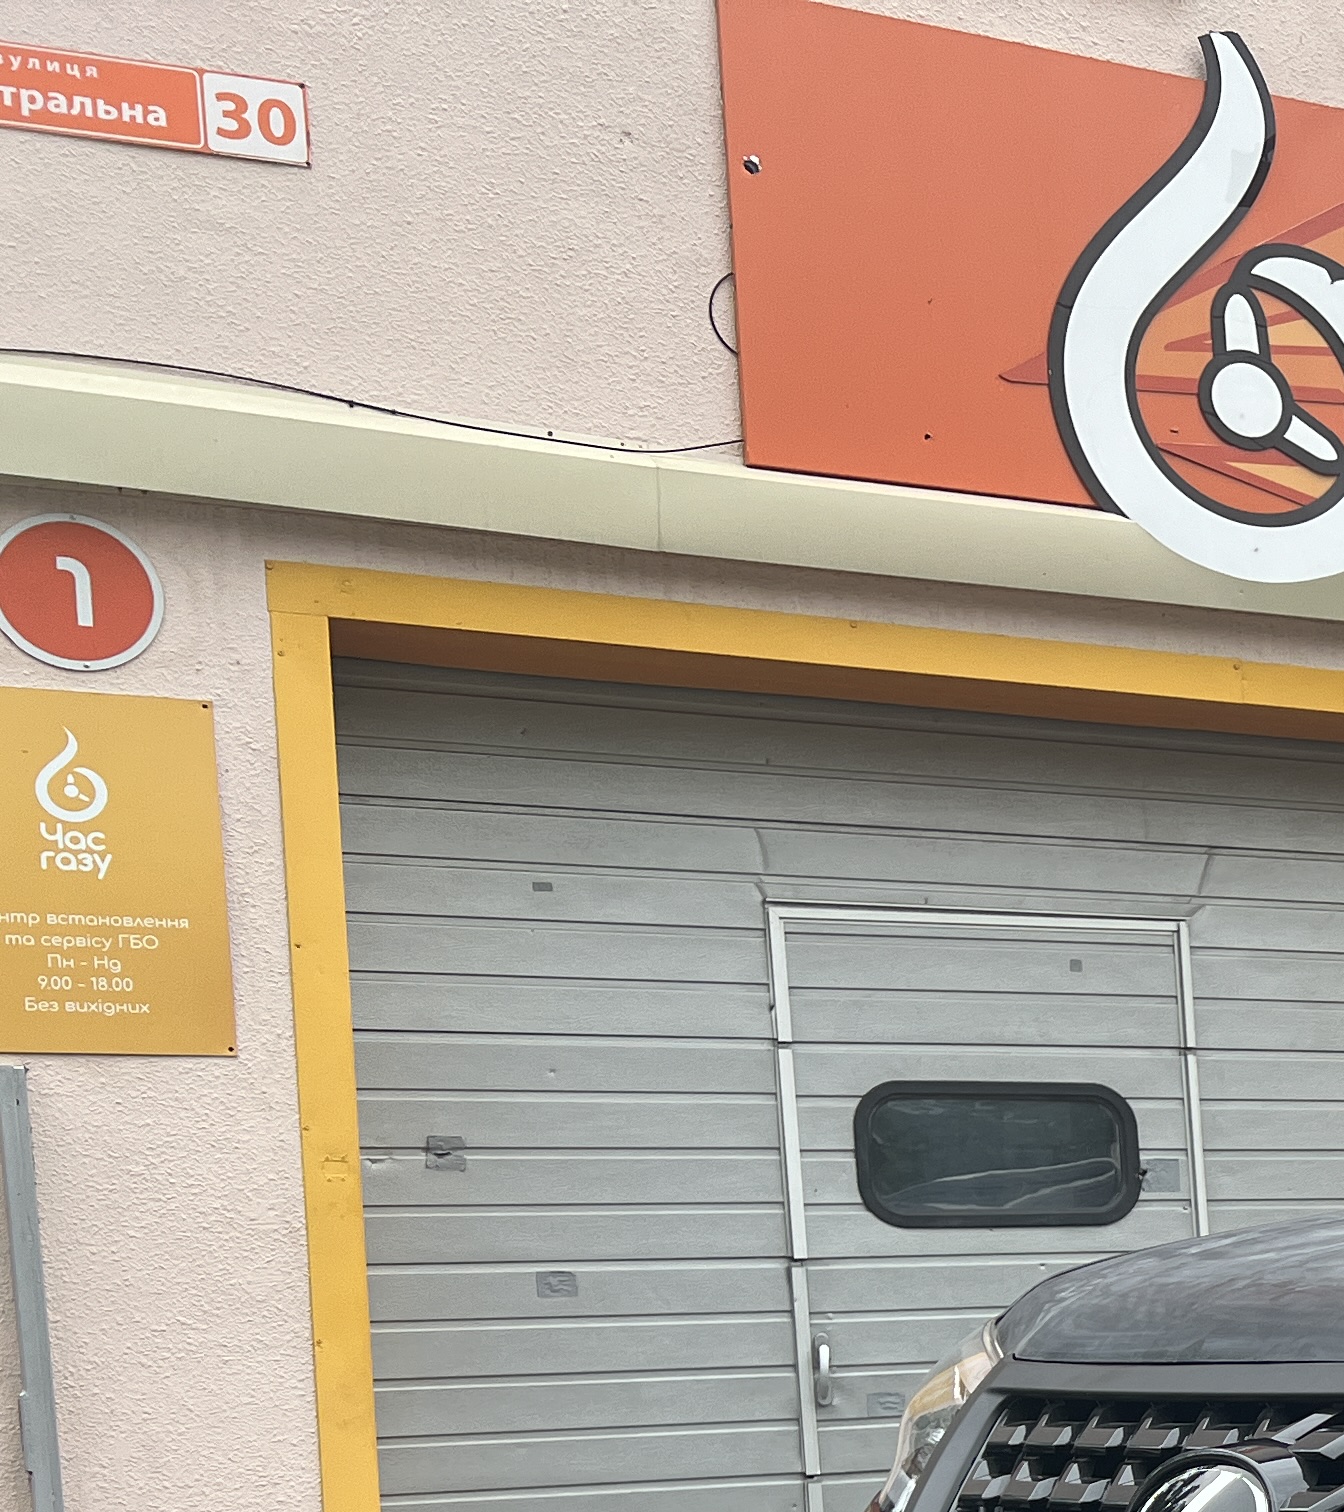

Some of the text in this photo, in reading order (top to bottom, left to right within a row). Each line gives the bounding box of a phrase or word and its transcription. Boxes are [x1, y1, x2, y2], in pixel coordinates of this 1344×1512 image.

[214, 92, 297, 146] 30
[55, 555, 94, 628] 1
[39, 822, 107, 851] Час
[39, 851, 113, 880] газу
[46, 913, 190, 929] встановлення
[5, 934, 160, 952] та сервісу ГБО
[47, 953, 75, 969] Пн
[93, 956, 122, 974] Нд
[37, 975, 73, 991] 9.00
[90, 977, 134, 992] 18.00
[24, 996, 151, 1017] Без вихідних
